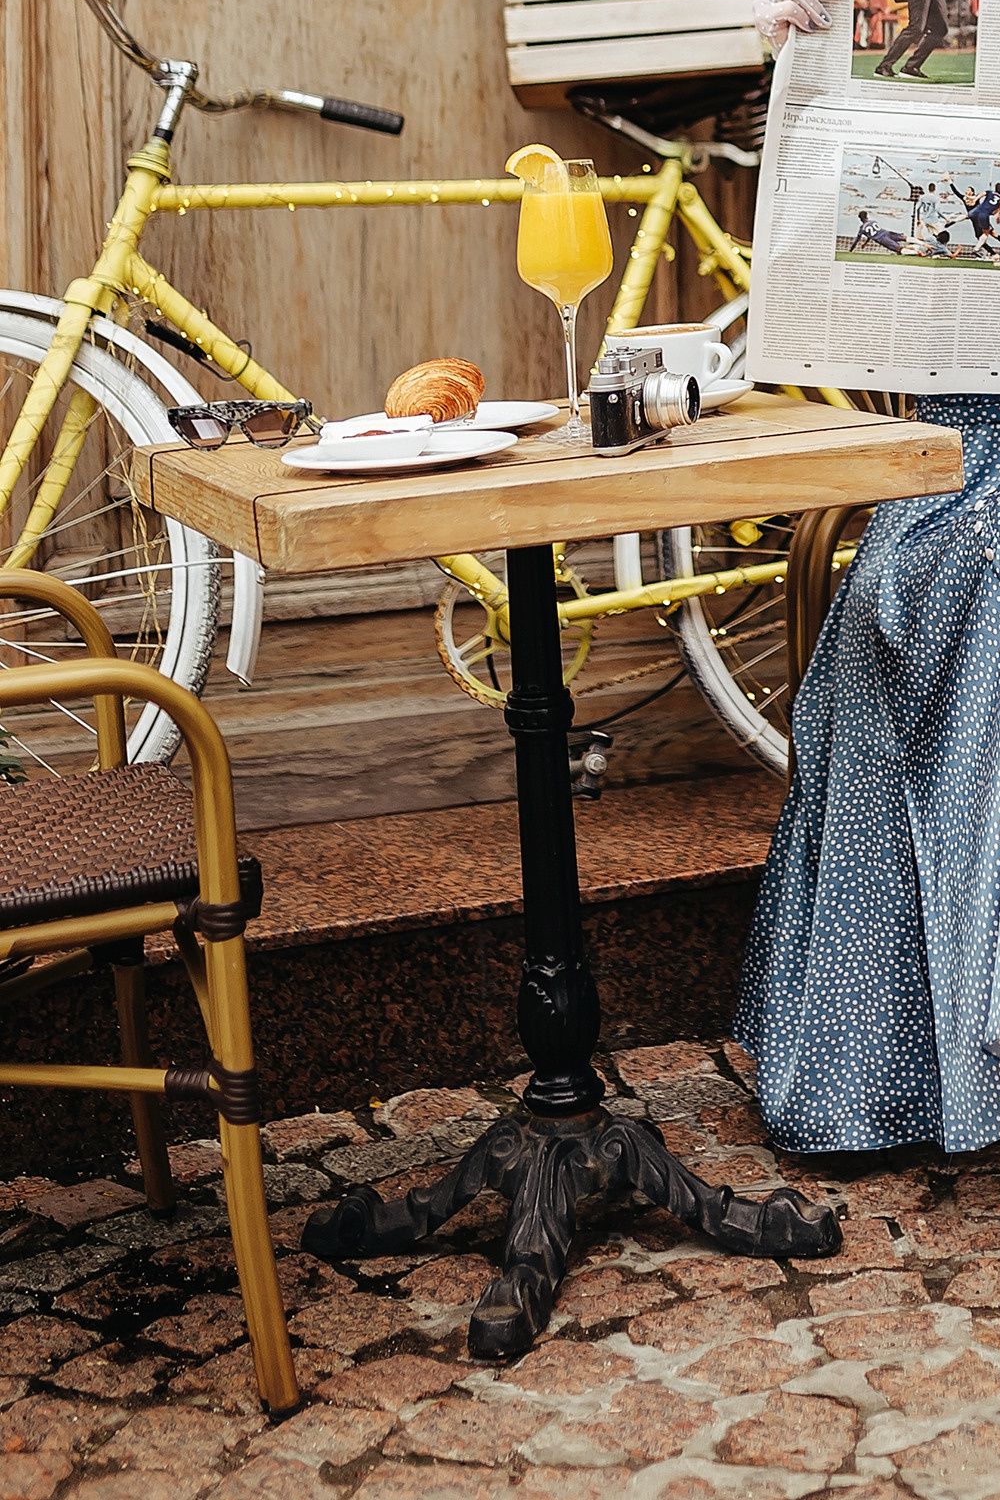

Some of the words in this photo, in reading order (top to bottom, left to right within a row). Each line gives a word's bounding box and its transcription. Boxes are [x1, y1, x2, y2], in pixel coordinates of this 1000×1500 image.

[783, 112, 804, 123] Игра
[805, 115, 852, 126] раскладов
[989, 195, 1000, 205] 3
[865, 222, 881, 237] 20
